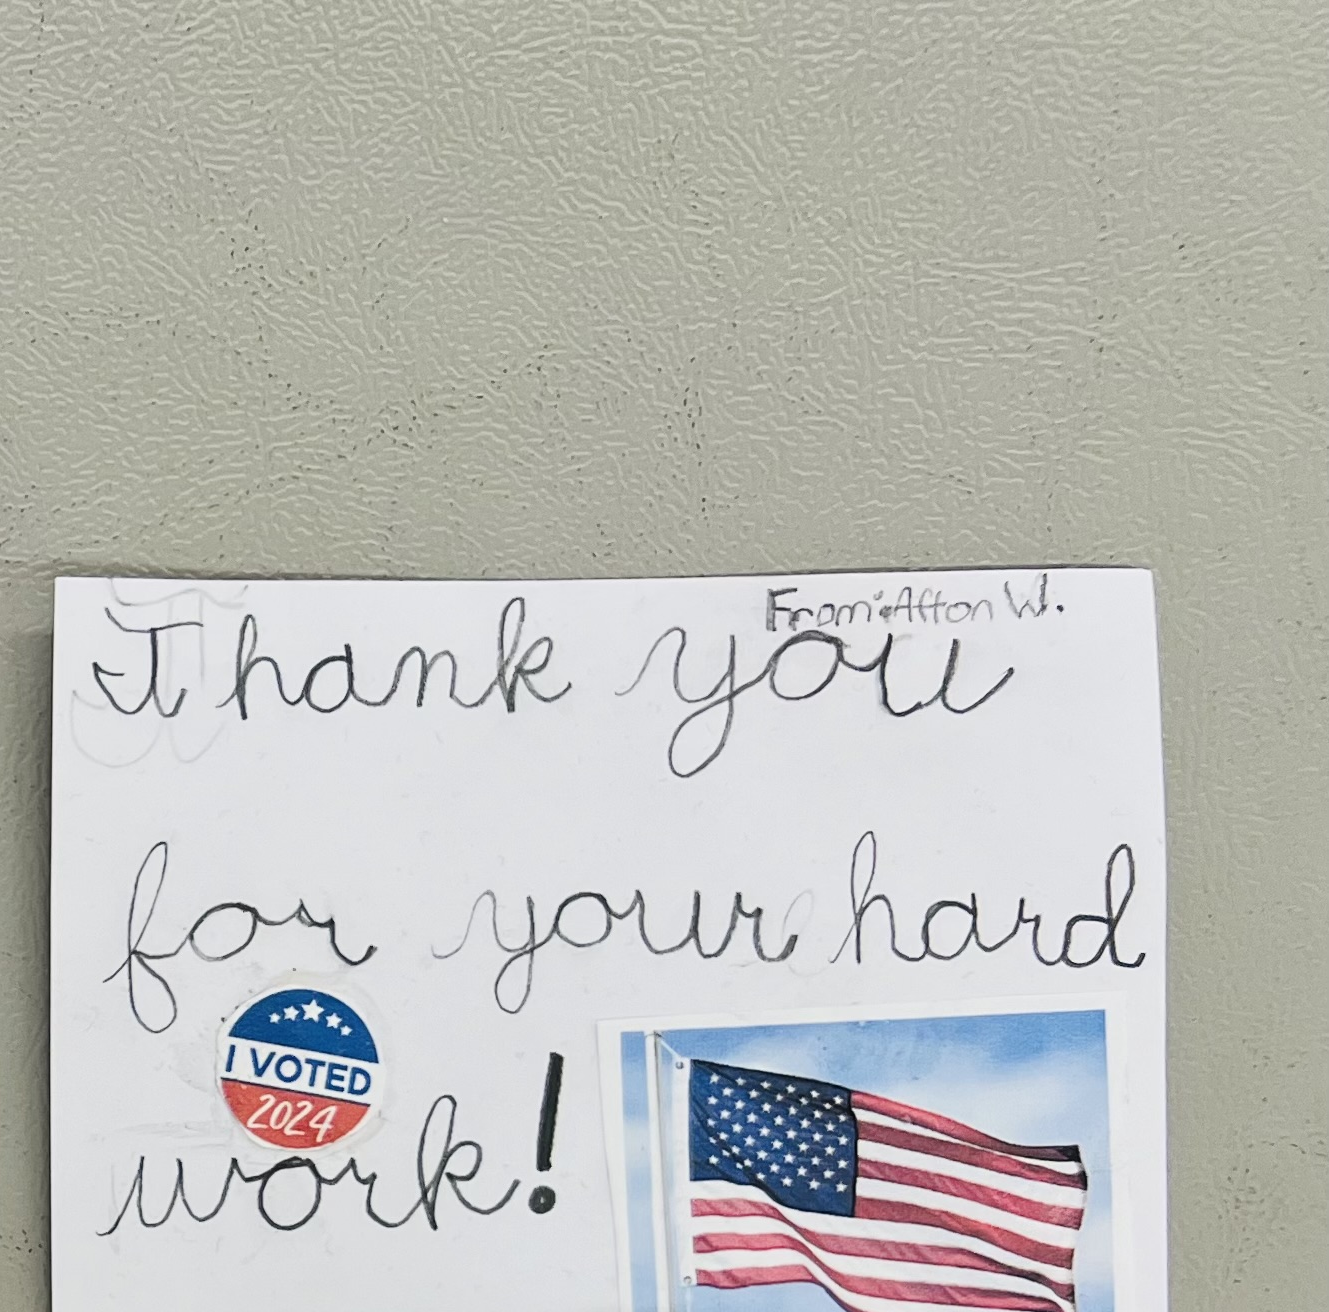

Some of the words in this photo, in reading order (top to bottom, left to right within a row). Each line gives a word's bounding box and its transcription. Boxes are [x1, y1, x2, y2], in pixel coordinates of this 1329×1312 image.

[1004, 573, 1064, 618] W.
[93, 596, 572, 720] Thank
[614, 627, 1015, 780] you
[103, 841, 377, 1033] for
[433, 889, 798, 1014] your
[830, 830, 1146, 968] hard
[226, 1044, 236, 1072] I
[250, 1048, 371, 1096] VOTED
[247, 1094, 337, 1142] 2024
[96, 1051, 564, 1236] work!
